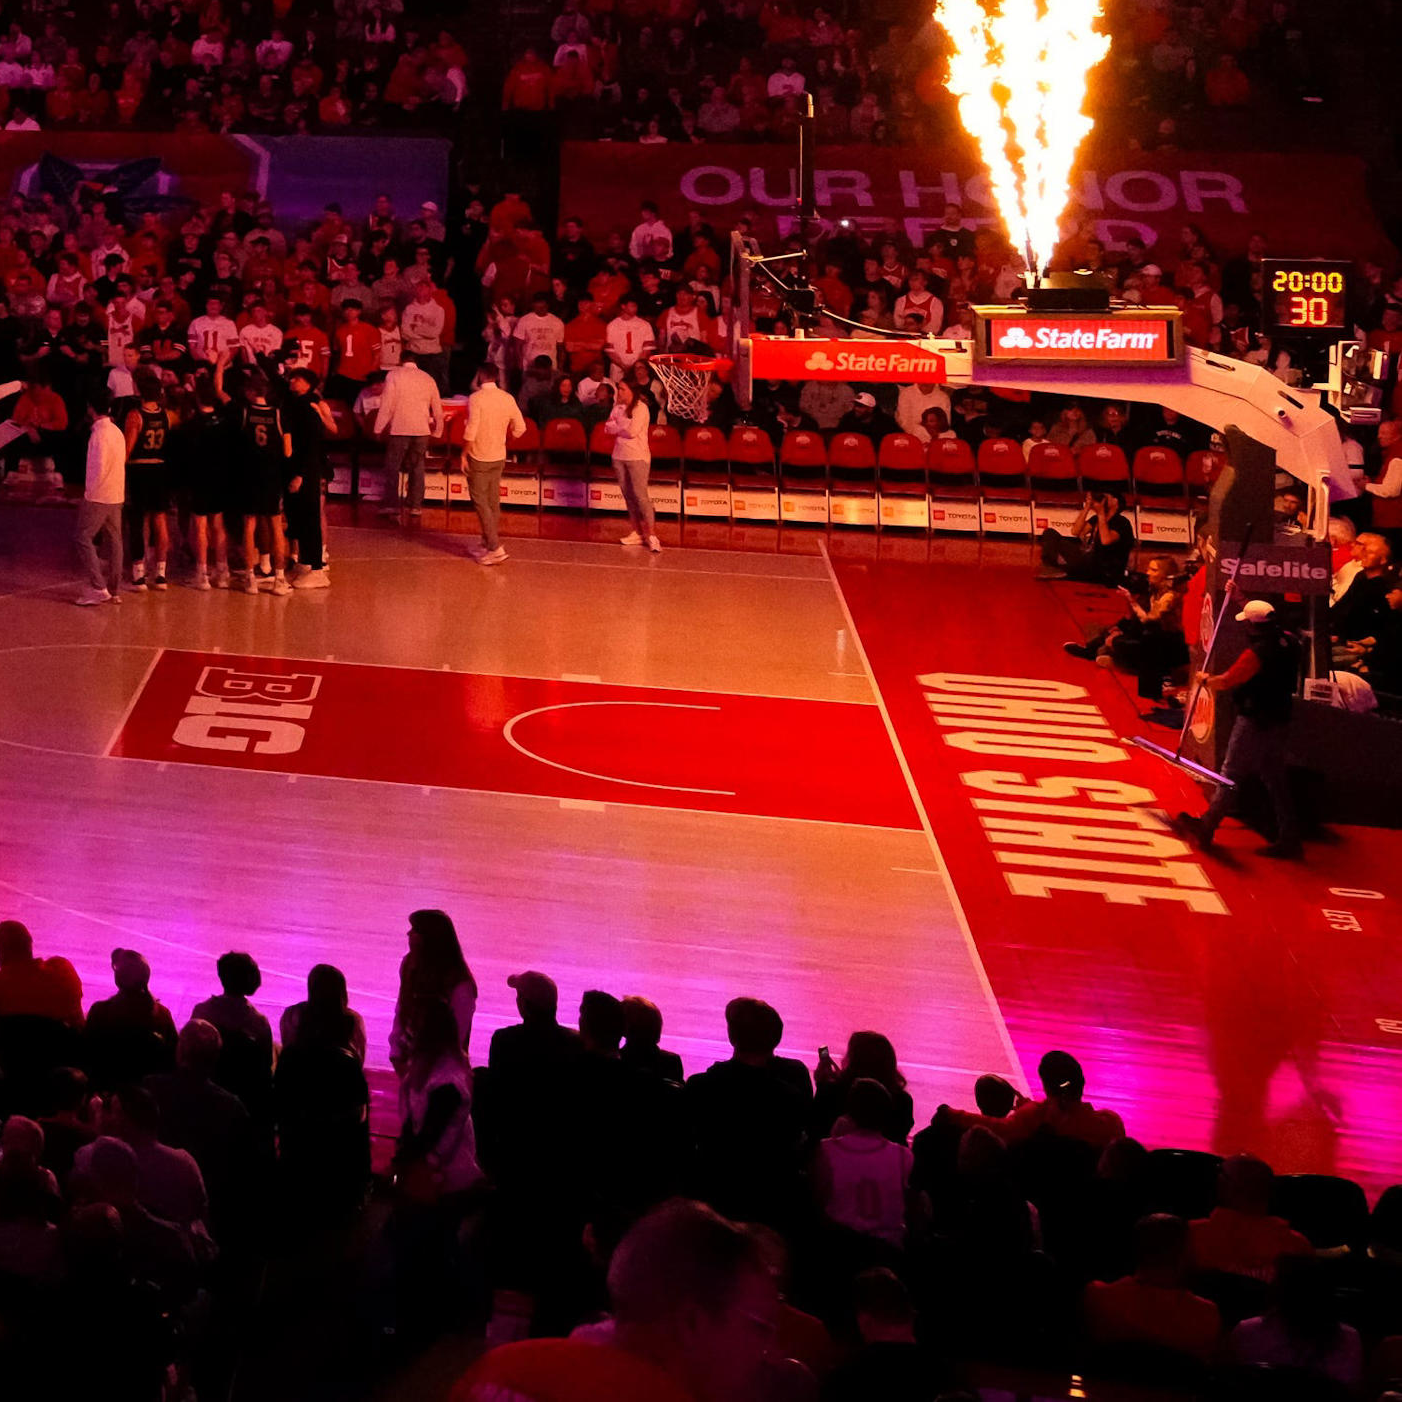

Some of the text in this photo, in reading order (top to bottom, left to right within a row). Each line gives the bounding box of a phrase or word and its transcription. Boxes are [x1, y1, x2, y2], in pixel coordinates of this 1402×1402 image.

[679, 165, 872, 206] OUR
[1272, 270, 1343, 294] 20:00
[1291, 296, 1328, 326] 30
[344, 334, 355, 358] 1
[626, 332, 633, 354] 1
[143, 428, 165, 450] 33
[254, 424, 268, 447] 6
[947, 512, 977, 521] TOYOTA
[999, 514, 1028, 523] TOYOTA
[1156, 525, 1186, 534] TOYOTA
[1220, 558, 1327, 580] Safelite
[172, 666, 323, 755] BIG
[915, 671, 1132, 763] OHIO
[960, 770, 1233, 916] STATE
